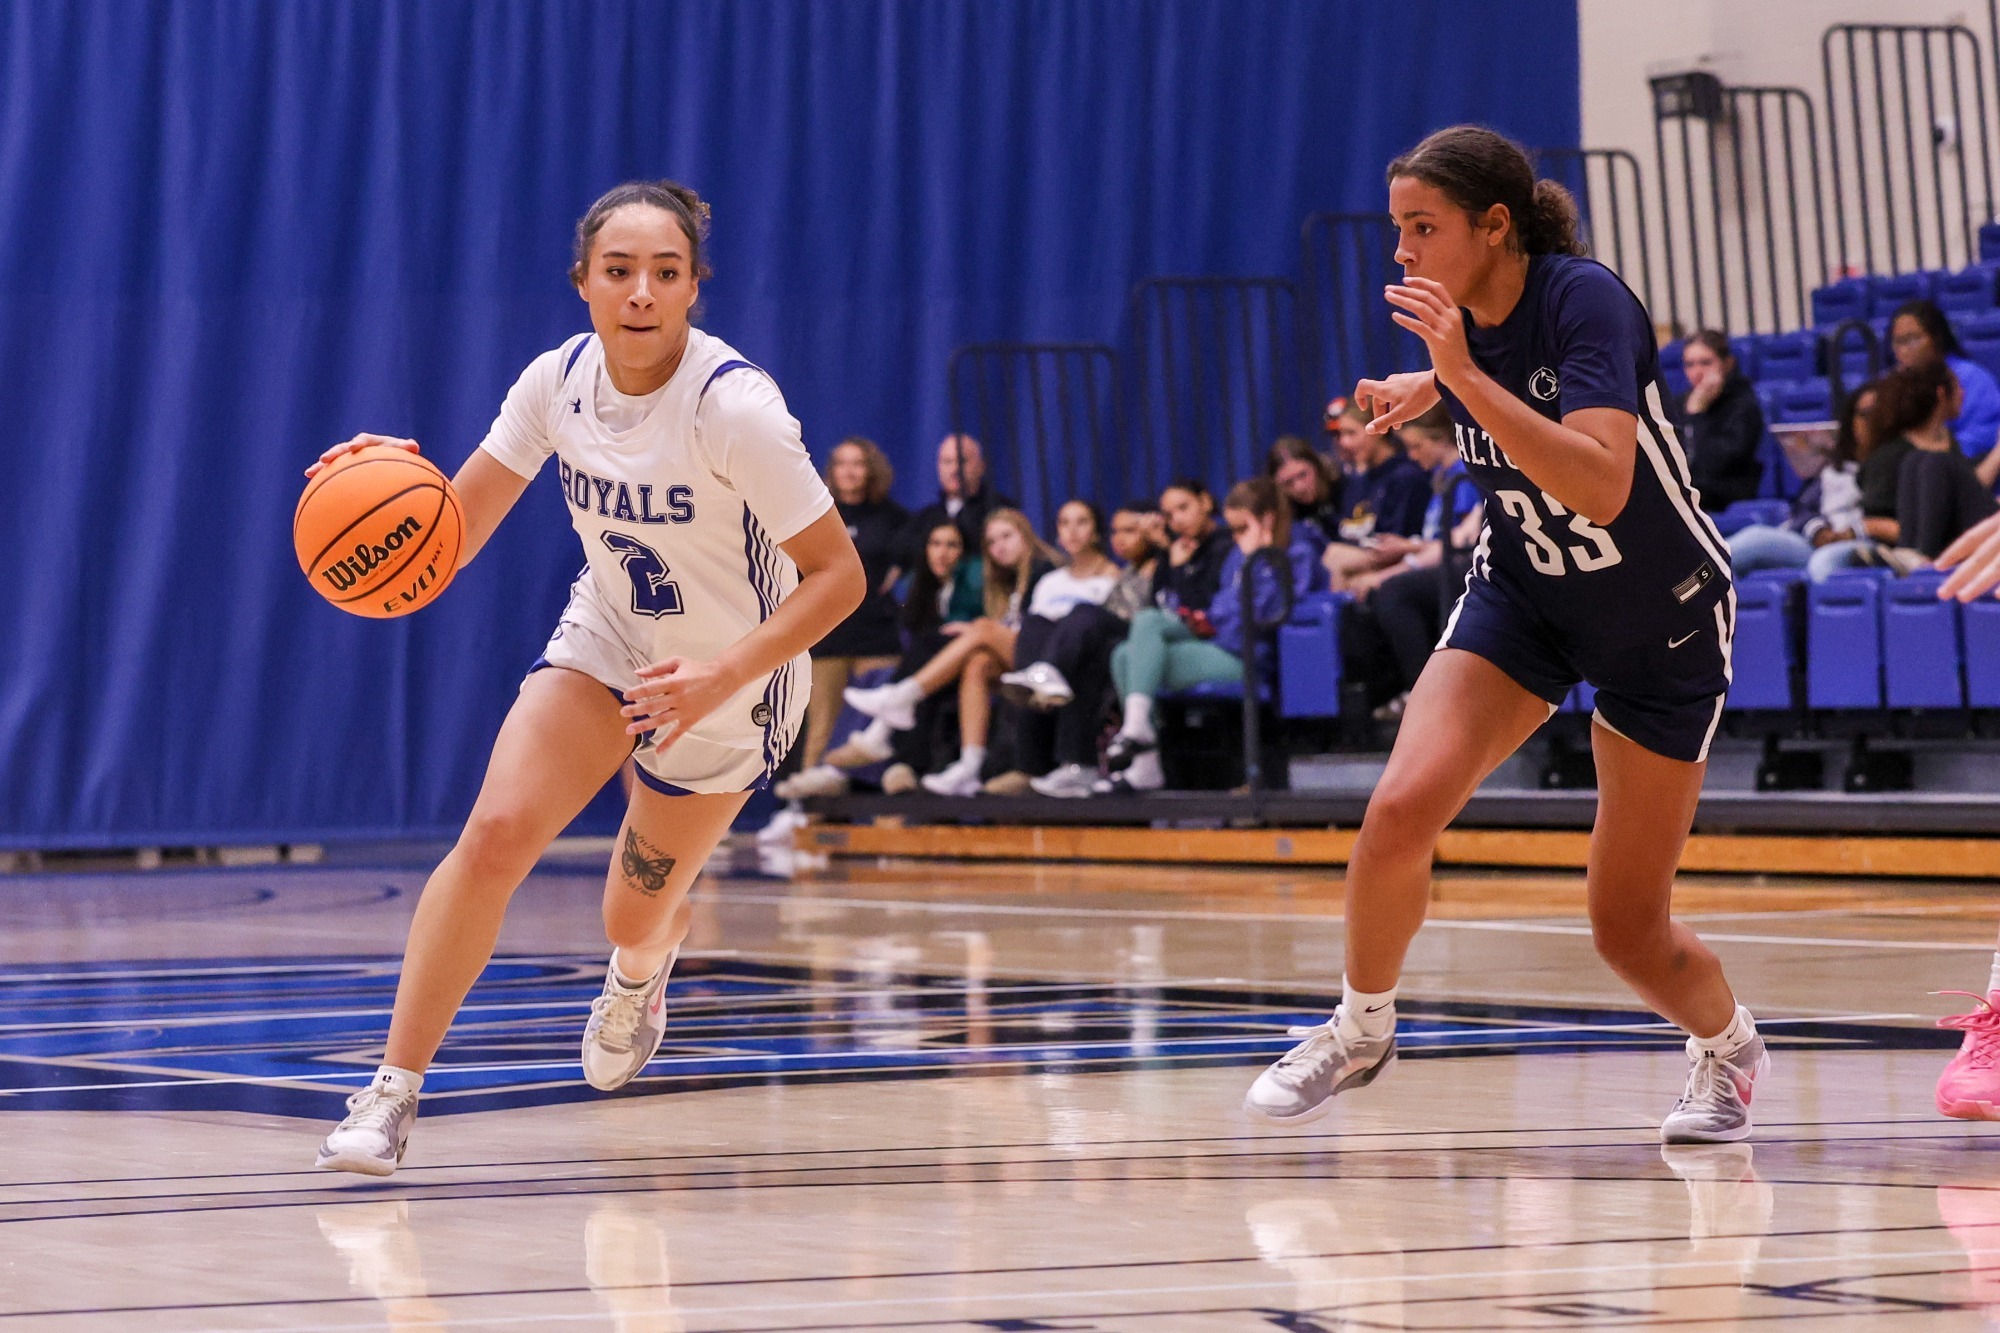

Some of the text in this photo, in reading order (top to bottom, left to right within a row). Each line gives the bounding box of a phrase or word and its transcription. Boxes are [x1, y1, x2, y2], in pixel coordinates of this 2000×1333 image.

[560, 457, 695, 524] ROYALS
[321, 514, 423, 592] Wilson
[1495, 490, 1622, 576] 33
[600, 530, 685, 620] 2
[1701, 570, 1709, 580] S
